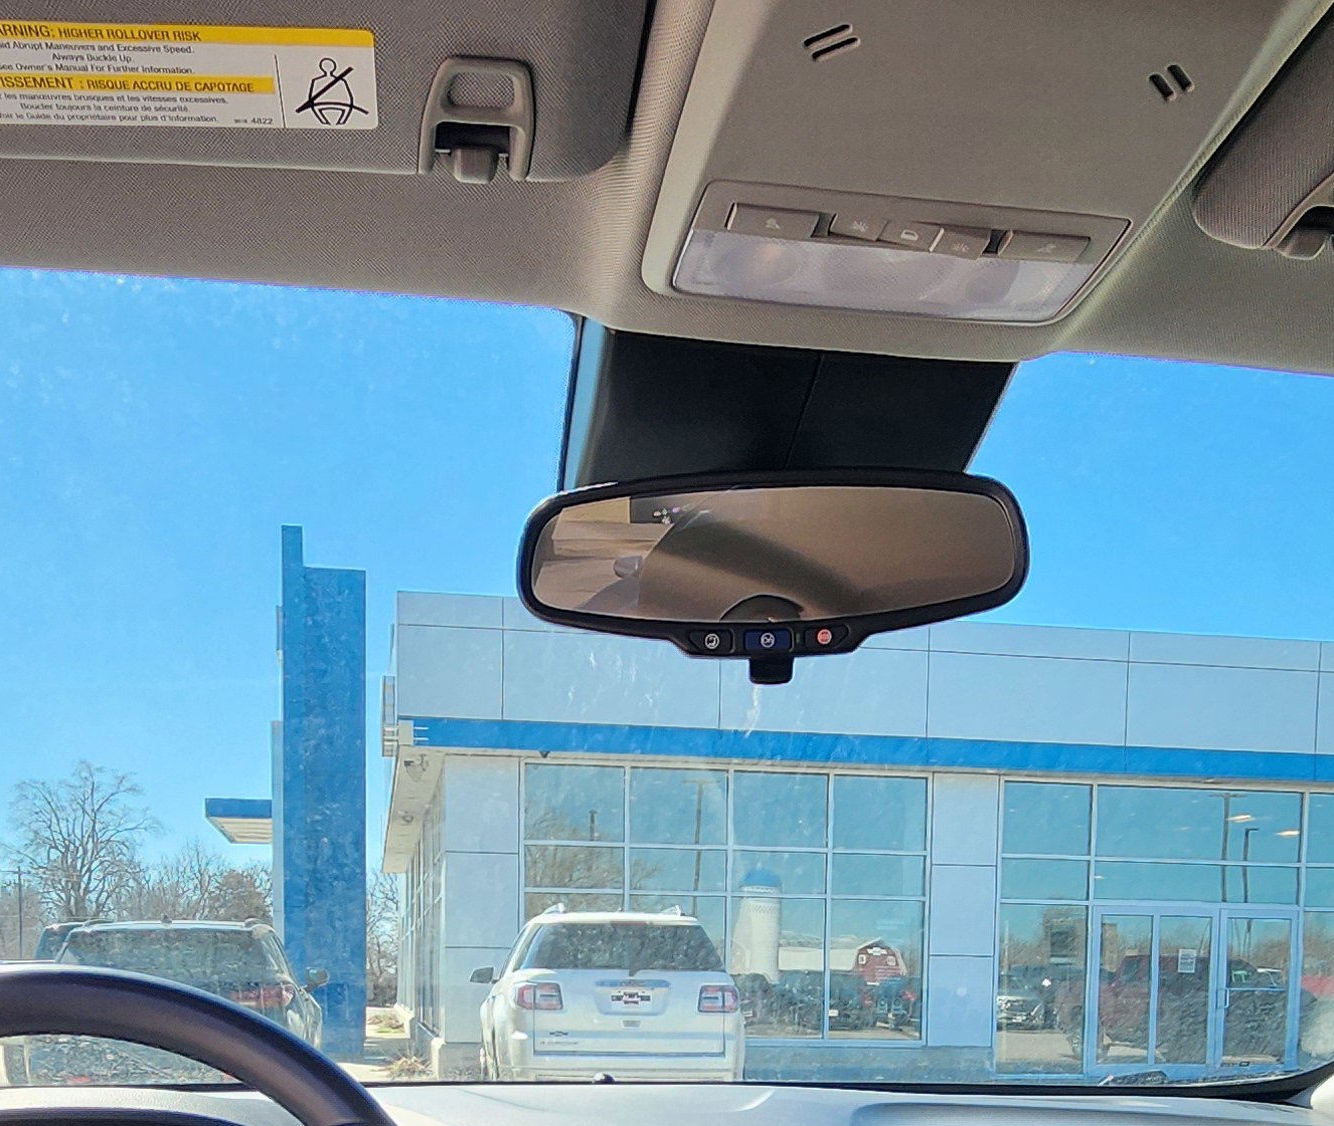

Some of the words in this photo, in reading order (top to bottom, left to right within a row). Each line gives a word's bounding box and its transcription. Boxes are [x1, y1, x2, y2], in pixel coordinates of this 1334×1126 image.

[58, 28, 104, 39] HIGHER
[107, 29, 170, 41] ROLLOVER
[173, 30, 202, 42] RISK
[87, 79, 131, 90] RISQUE
[132, 80, 172, 91] ACCRU
[175, 81, 193, 91] DE
[194, 82, 255, 93] CAPOTAGE
